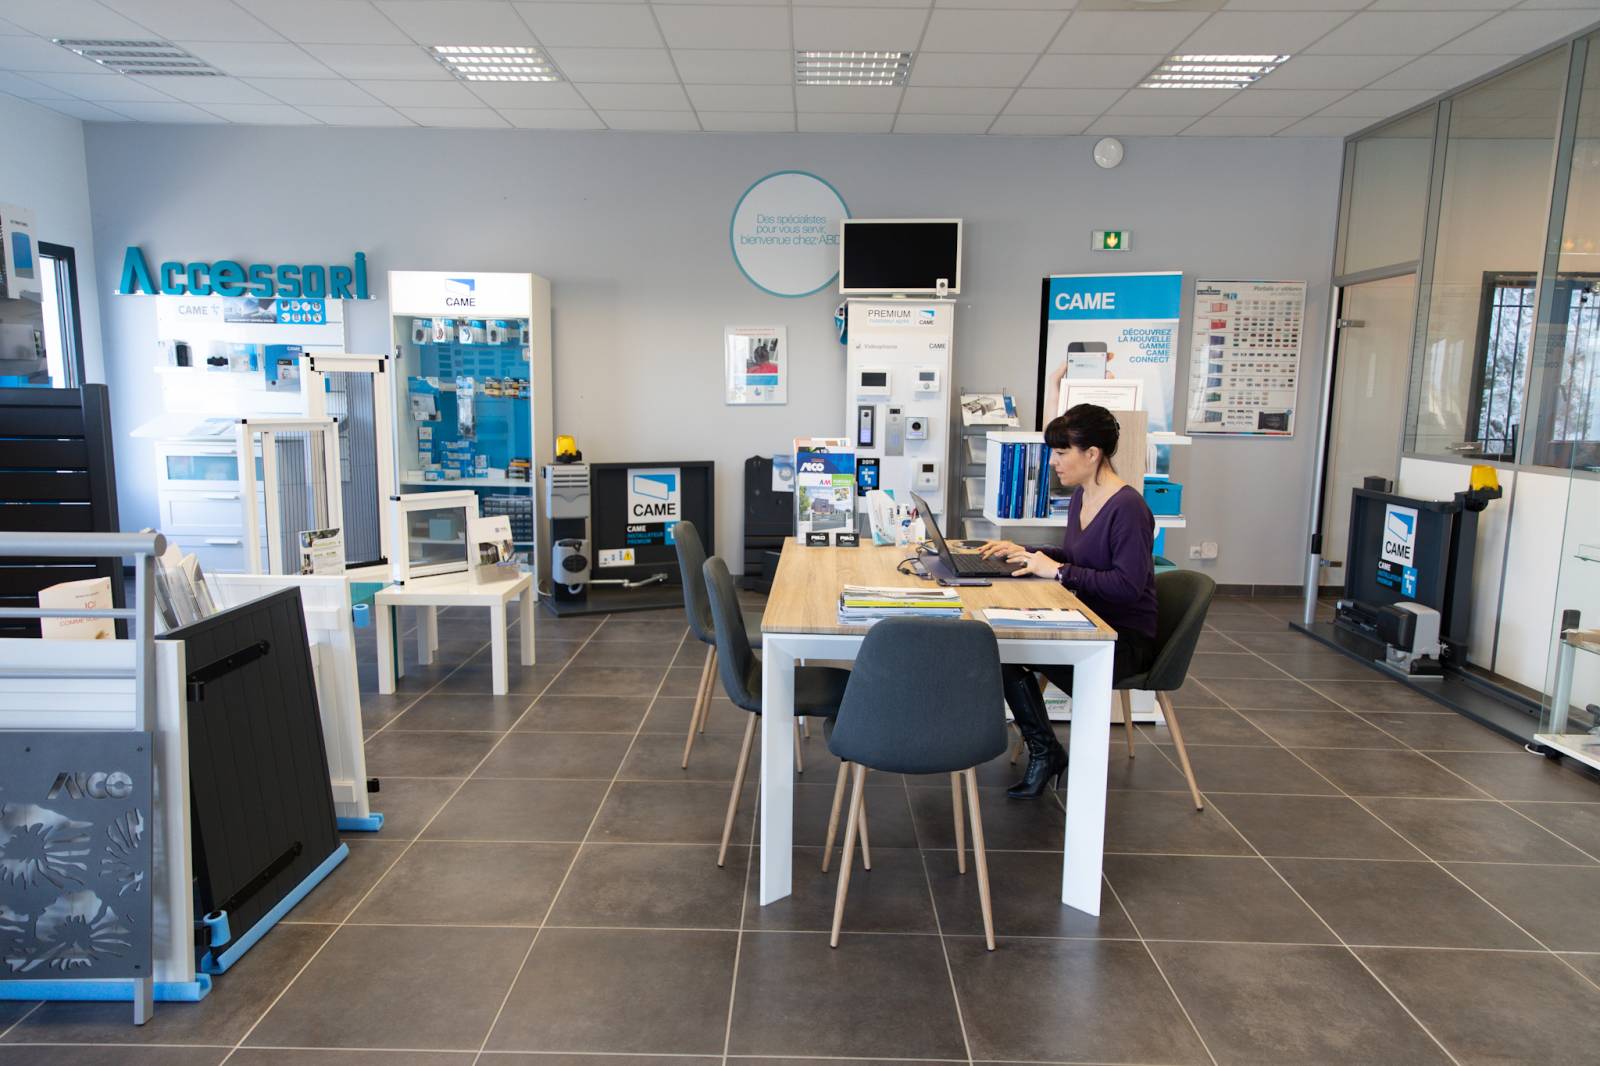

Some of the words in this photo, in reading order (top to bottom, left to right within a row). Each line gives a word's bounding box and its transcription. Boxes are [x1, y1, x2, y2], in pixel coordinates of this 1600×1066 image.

[756, 214, 775, 224] Des
[777, 214, 826, 226] spécialistes
[756, 225, 776, 234] pour
[740, 235, 790, 245] bienvenue
[445, 298, 476, 307] CAME
[1055, 292, 1116, 310] CAME
[178, 305, 209, 315] CAME
[867, 309, 911, 318] PREMIUM
[1122, 327, 1172, 336] DÉCOUVREZ
[1130, 335, 1171, 343] NOUVELLE
[633, 503, 676, 517] CAME
[627, 525, 647, 533] CAME
[1385, 540, 1411, 560] CAME
[1378, 561, 1391, 571] CAME
